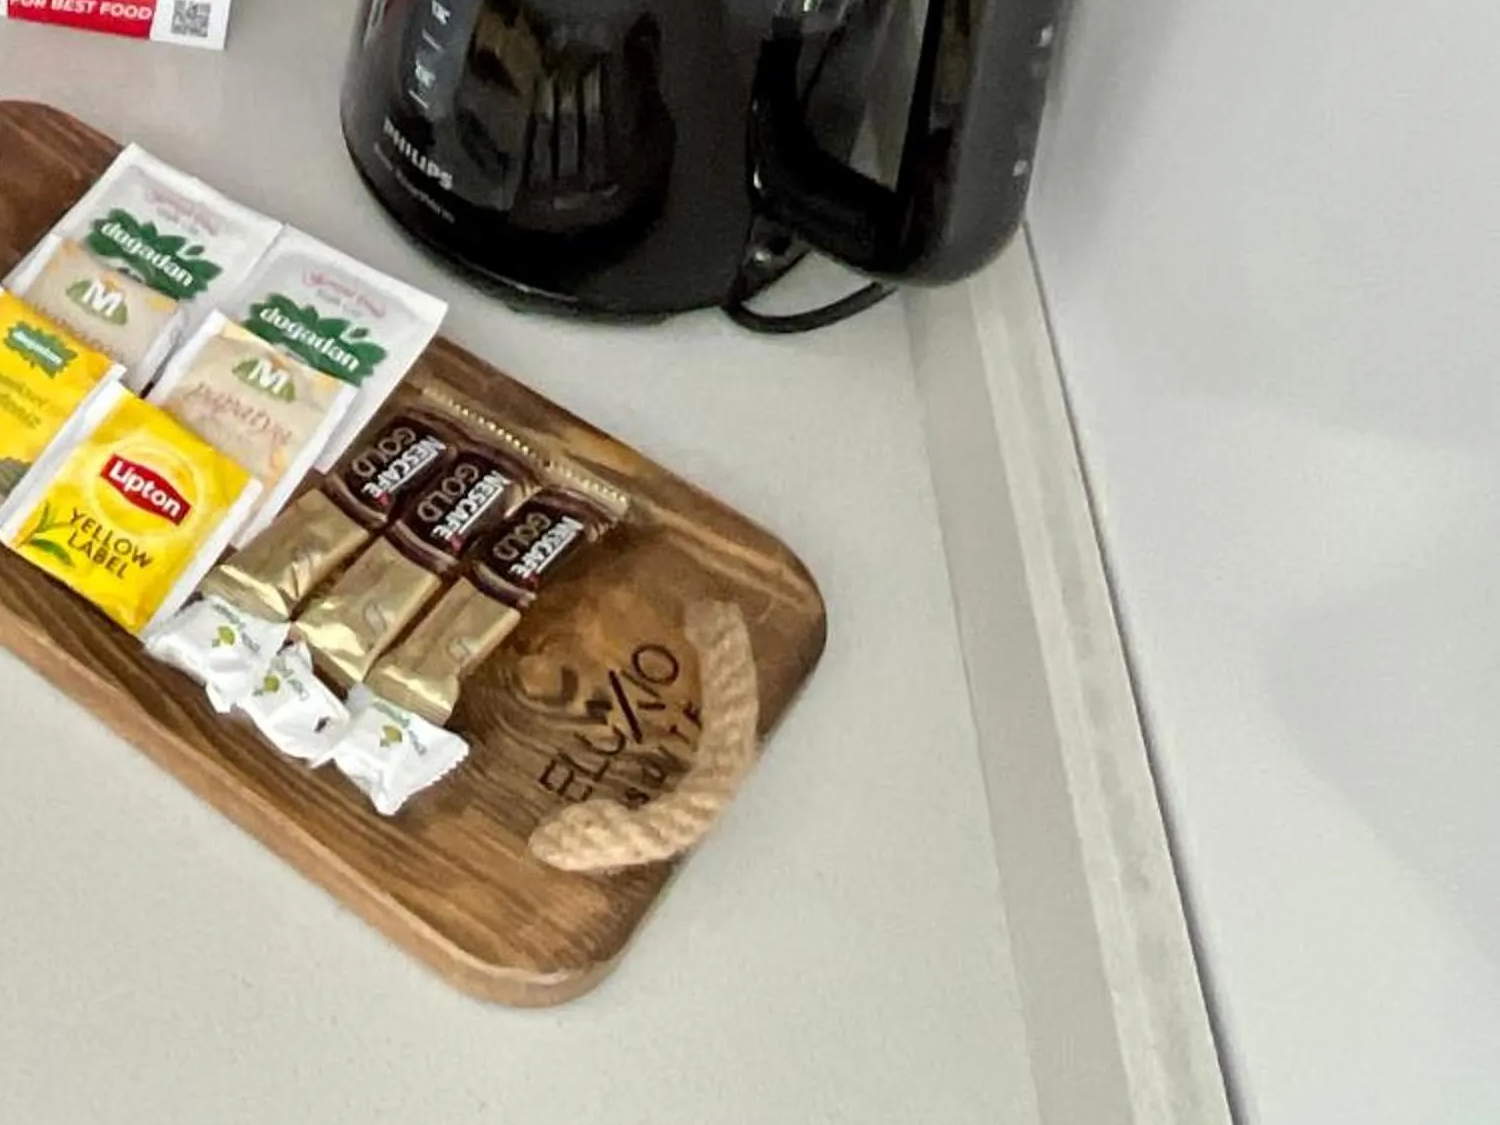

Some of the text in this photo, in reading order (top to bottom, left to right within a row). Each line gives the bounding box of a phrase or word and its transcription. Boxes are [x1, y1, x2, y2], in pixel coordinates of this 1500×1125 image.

[99, 0, 153, 21] FOOD
[352, 427, 416, 478] GOLD
[107, 458, 183, 518] Lipton
[417, 463, 479, 523] GOLD
[68, 508, 156, 569] YELLOW
[68, 532, 127, 580] LABEL
[493, 511, 551, 561] GOLD
